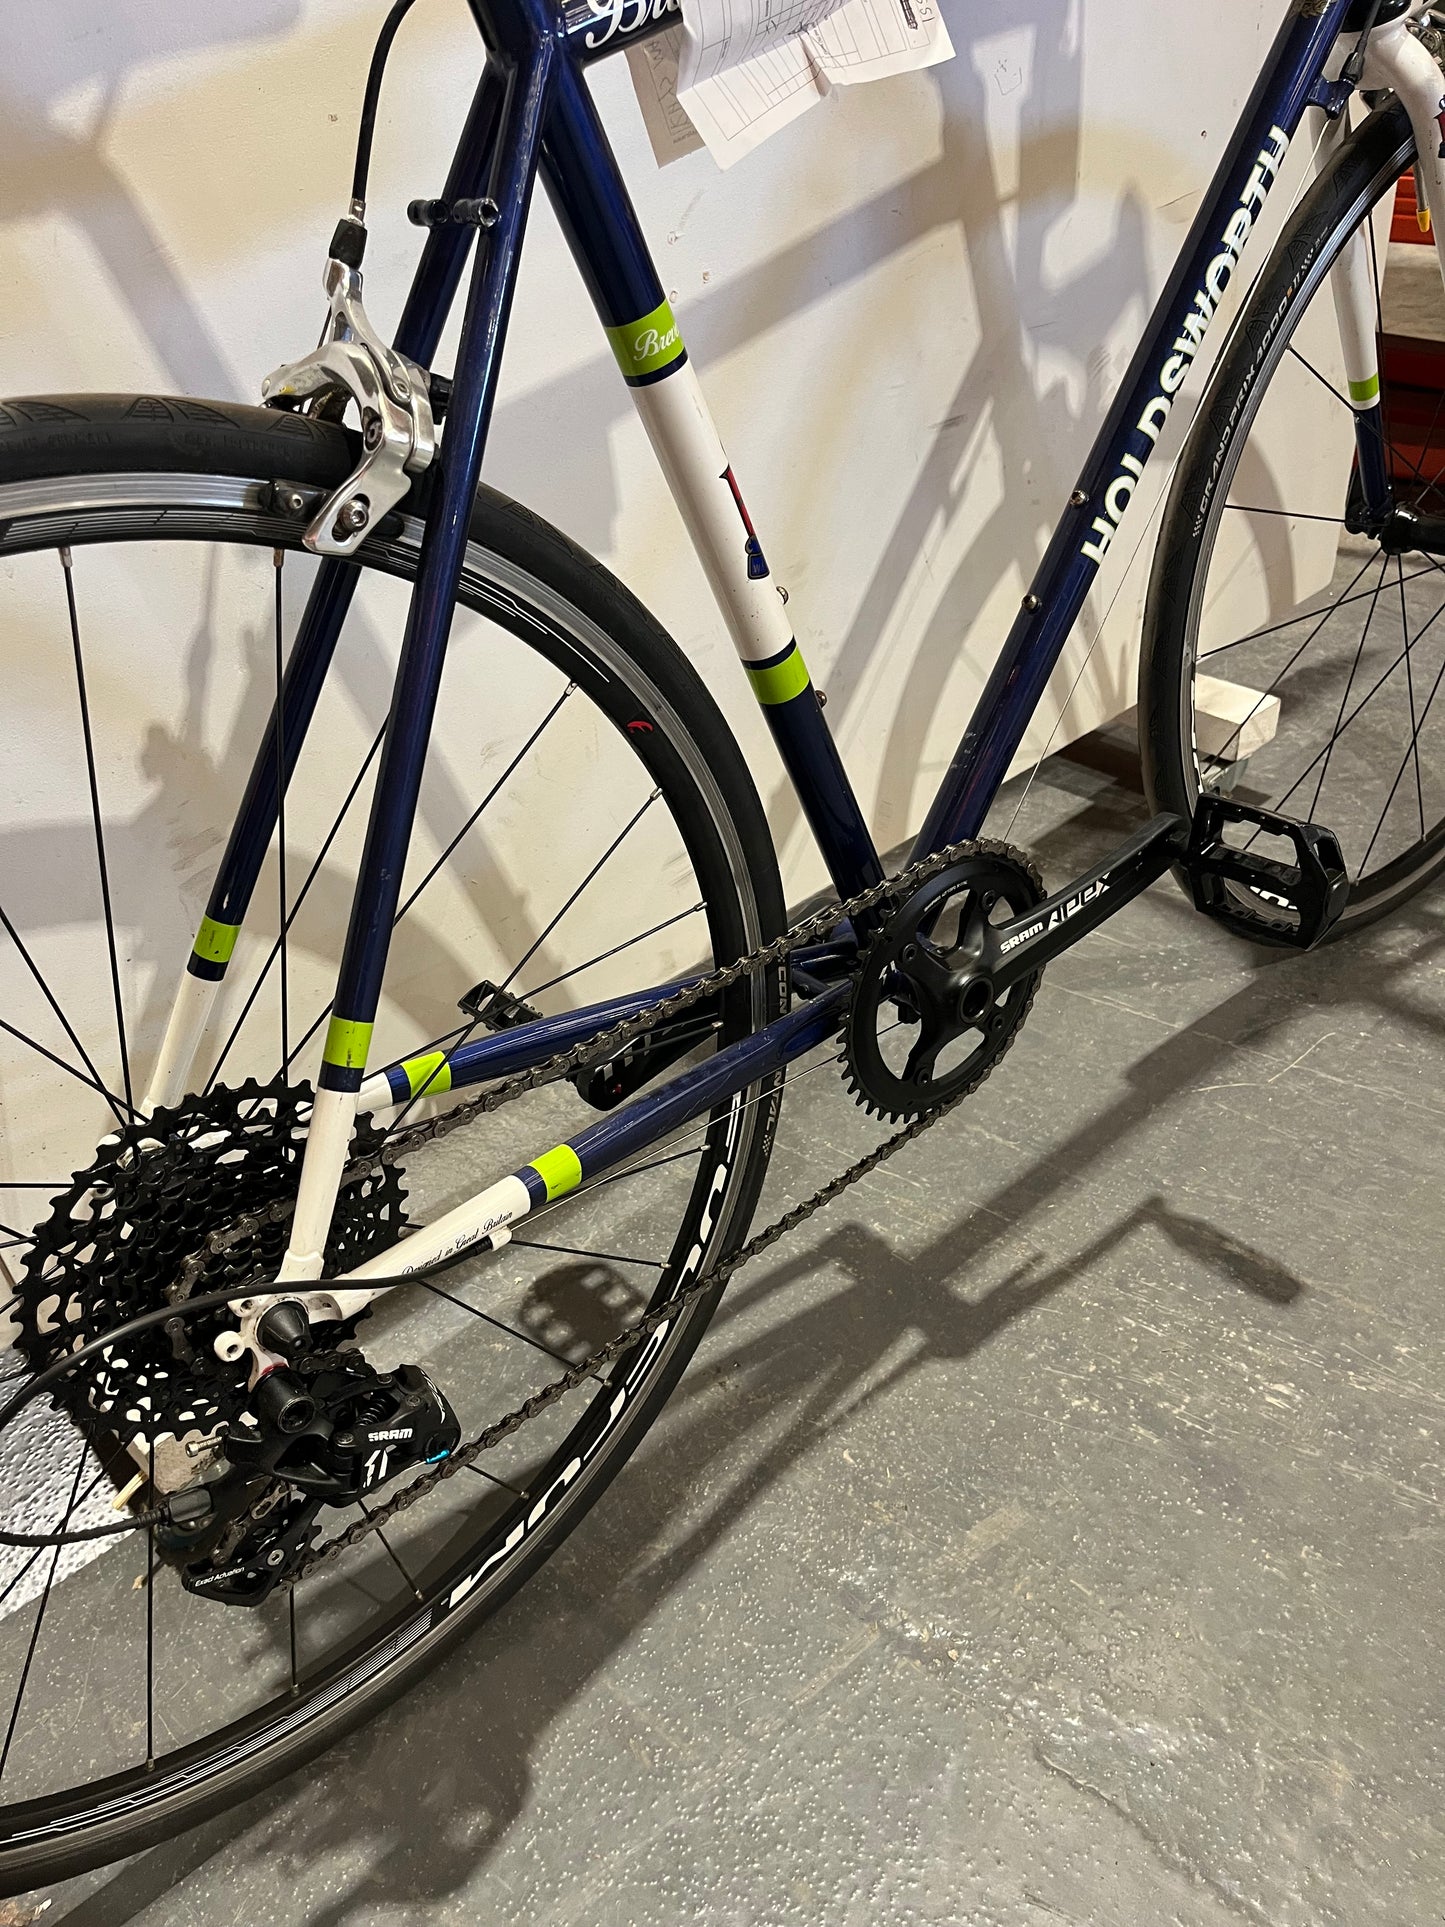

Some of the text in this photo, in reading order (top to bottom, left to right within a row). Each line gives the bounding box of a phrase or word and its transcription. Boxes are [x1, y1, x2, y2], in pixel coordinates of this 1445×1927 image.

[1200, 425, 1231, 514] GRAND
[1229, 364, 1256, 427] PRIX
[1000, 921, 1045, 955] SRAM
[455, 1227, 480, 1250] Great
[482, 1210, 513, 1235] Britain
[367, 1428, 413, 1441] SRAM
[195, 1566, 245, 1587] Exact Actuation
